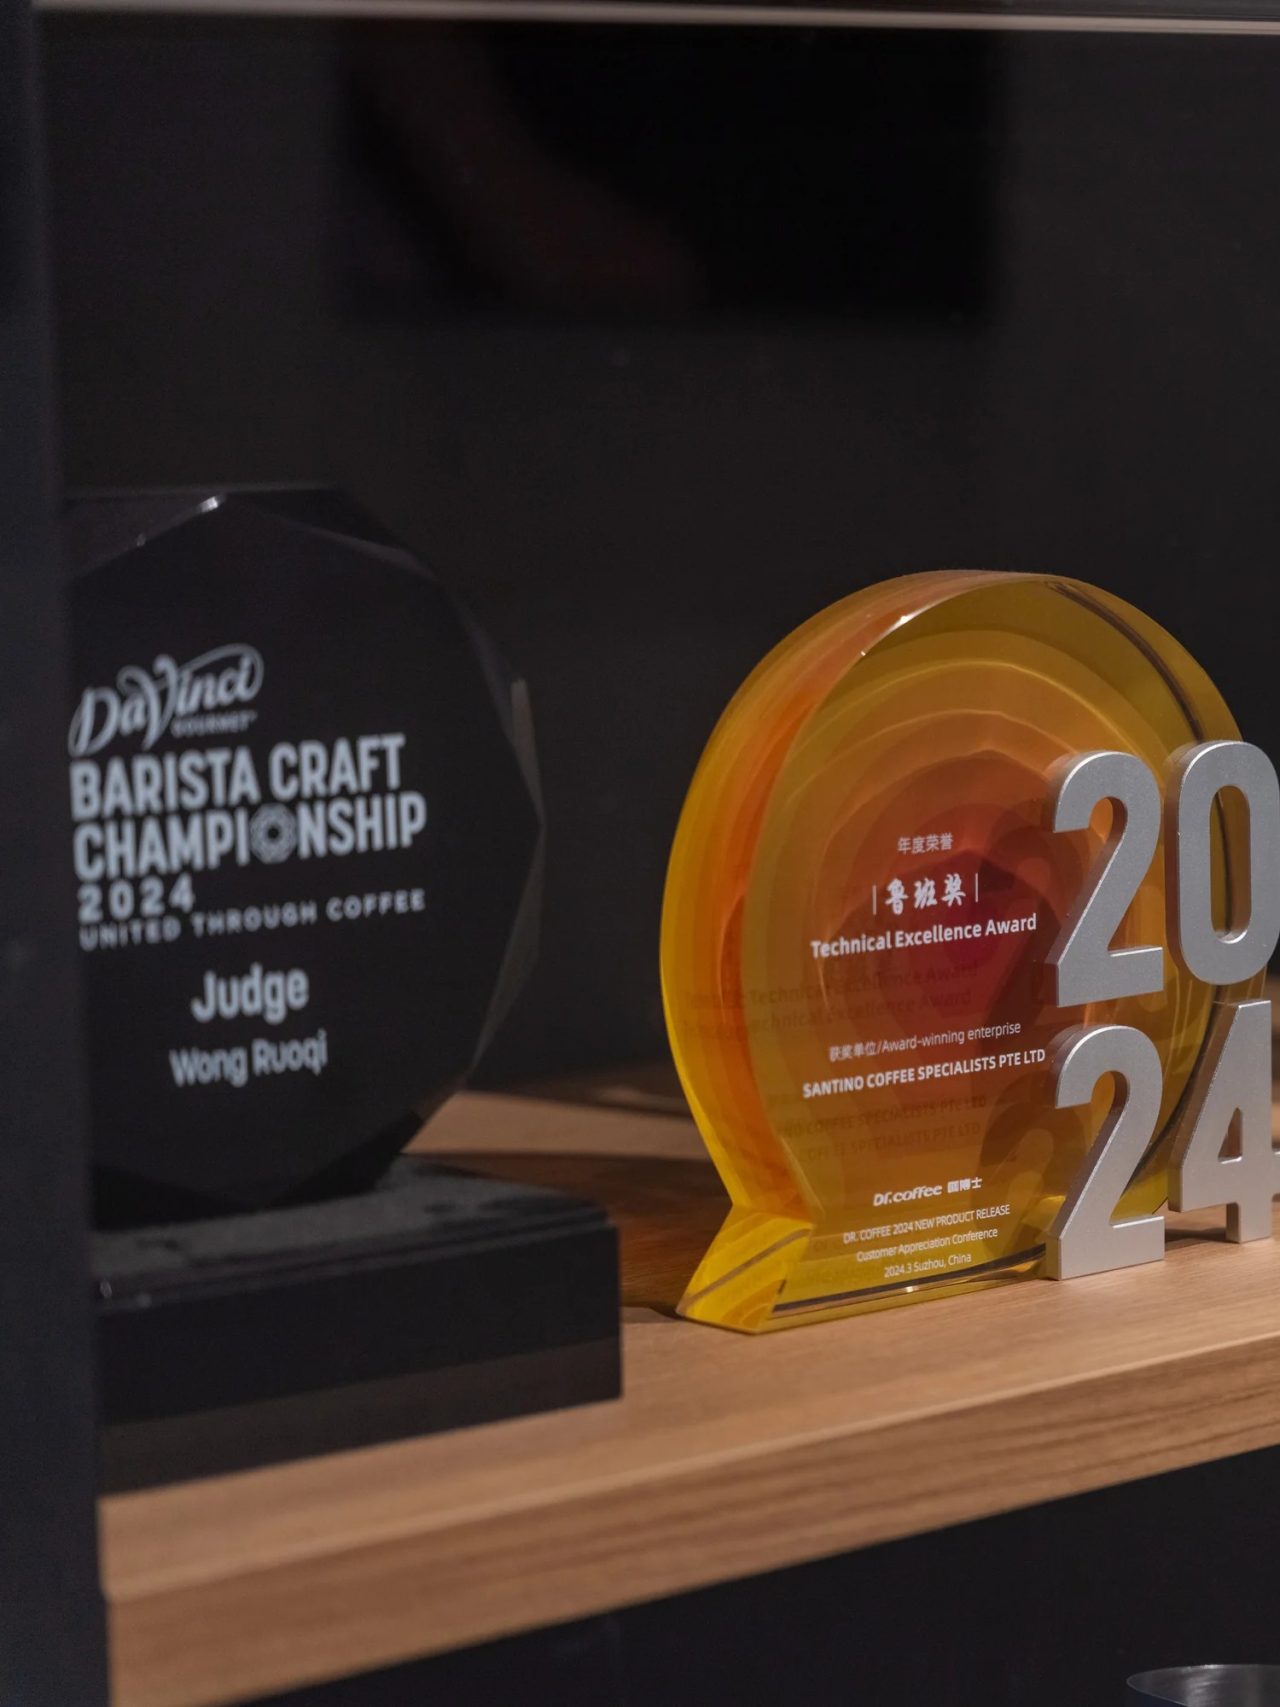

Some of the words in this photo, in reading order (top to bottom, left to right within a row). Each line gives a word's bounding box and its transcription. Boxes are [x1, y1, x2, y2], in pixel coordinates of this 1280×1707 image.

[69, 643, 264, 757] DaVinci
[70, 745, 261, 821] BARISTA
[269, 732, 405, 800] CRAFT
[73, 791, 426, 882] CHAMPIONSHIP
[78, 873, 195, 923] 2024
[79, 915, 181, 950] UNITED
[191, 898, 318, 936] THROUGH
[326, 888, 425, 922] COFFEE
[811, 931, 891, 959] Technical
[895, 921, 981, 948] Excellence
[985, 913, 1037, 936] Award
[191, 962, 309, 1024] Judge
[967, 1022, 1021, 1041] enterprise
[170, 1046, 248, 1088] Wong
[253, 1028, 328, 1076] Ruoqi
[803, 1075, 864, 1099] SANTINO
[866, 1067, 915, 1088] COFFEE
[918, 1054, 996, 1080] SPECIALISTS
[999, 1052, 1021, 1068] PTE
[1024, 1049, 1045, 1065] LTD
[873, 1185, 942, 1206] Dr.coffee
[857, 1246, 898, 1262] Customer
[898, 1237, 950, 1255] Appreciation
[952, 1227, 998, 1245] Conference
[860, 1226, 891, 1241] COFFEE
[893, 1221, 913, 1234] 2024
[915, 1218, 935, 1231] NEW
[936, 1211, 975, 1228] PRODUCT
[976, 1204, 1010, 1220] RELEASE
[884, 1263, 912, 1278] 2024.3
[914, 1257, 946, 1273] Suzhou,
[948, 1252, 972, 1266] China
